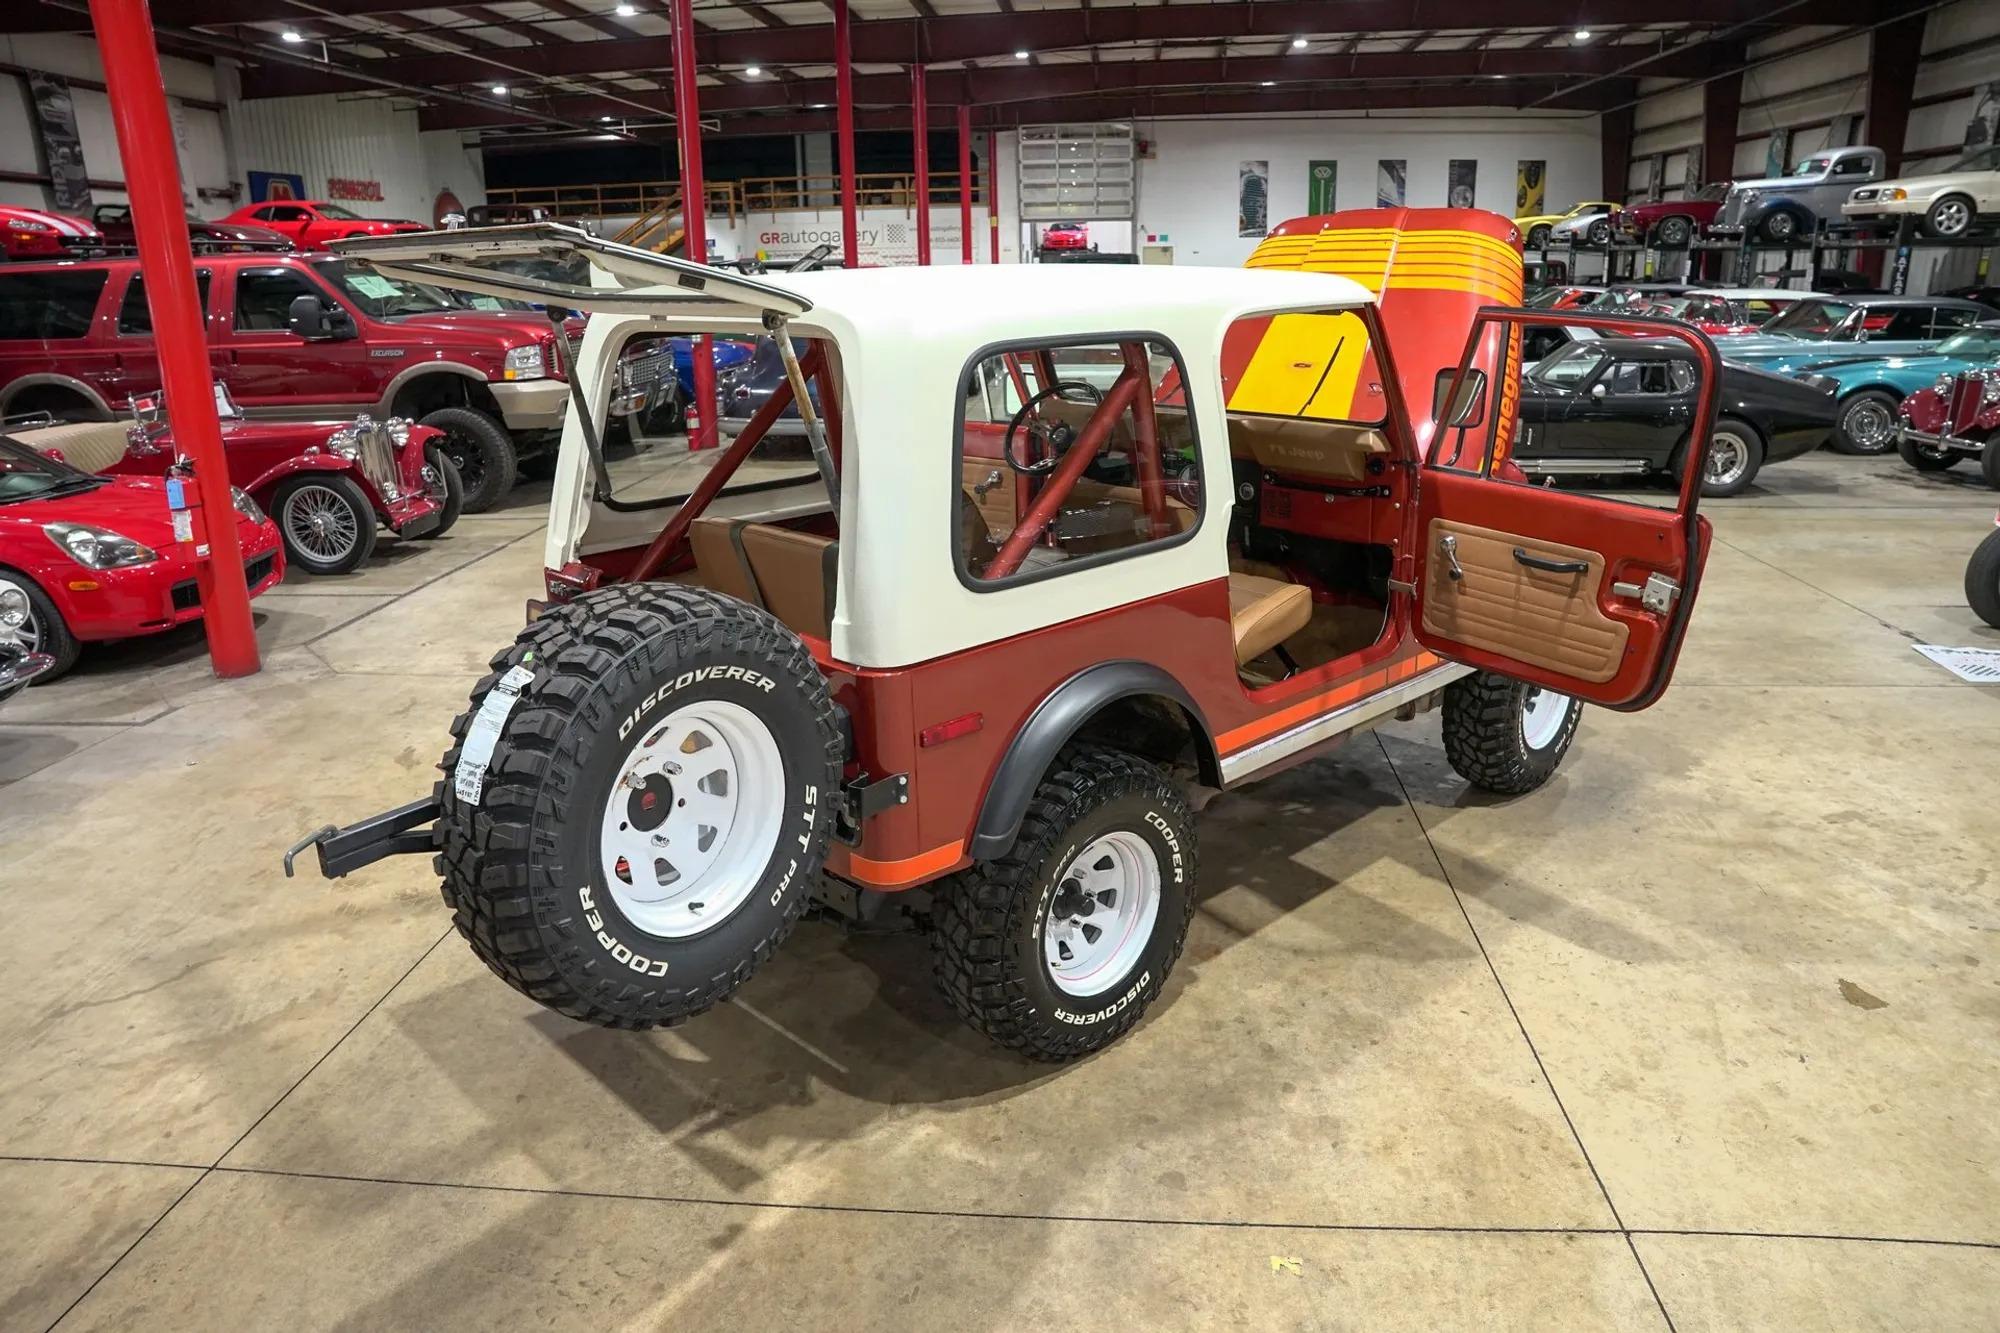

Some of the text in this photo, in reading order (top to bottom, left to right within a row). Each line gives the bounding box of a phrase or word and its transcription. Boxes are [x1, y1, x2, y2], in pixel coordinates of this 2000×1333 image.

[760, 227, 879, 247] GRautogaery
[1893, 257, 1907, 295] ATLAS
[617, 664, 776, 742] DISCOVERER
[770, 784, 817, 908] STT PRO
[1144, 811, 1184, 884] COOPER
[578, 885, 669, 978] COOPER
[1054, 970, 1150, 1025] DISCOVERER
